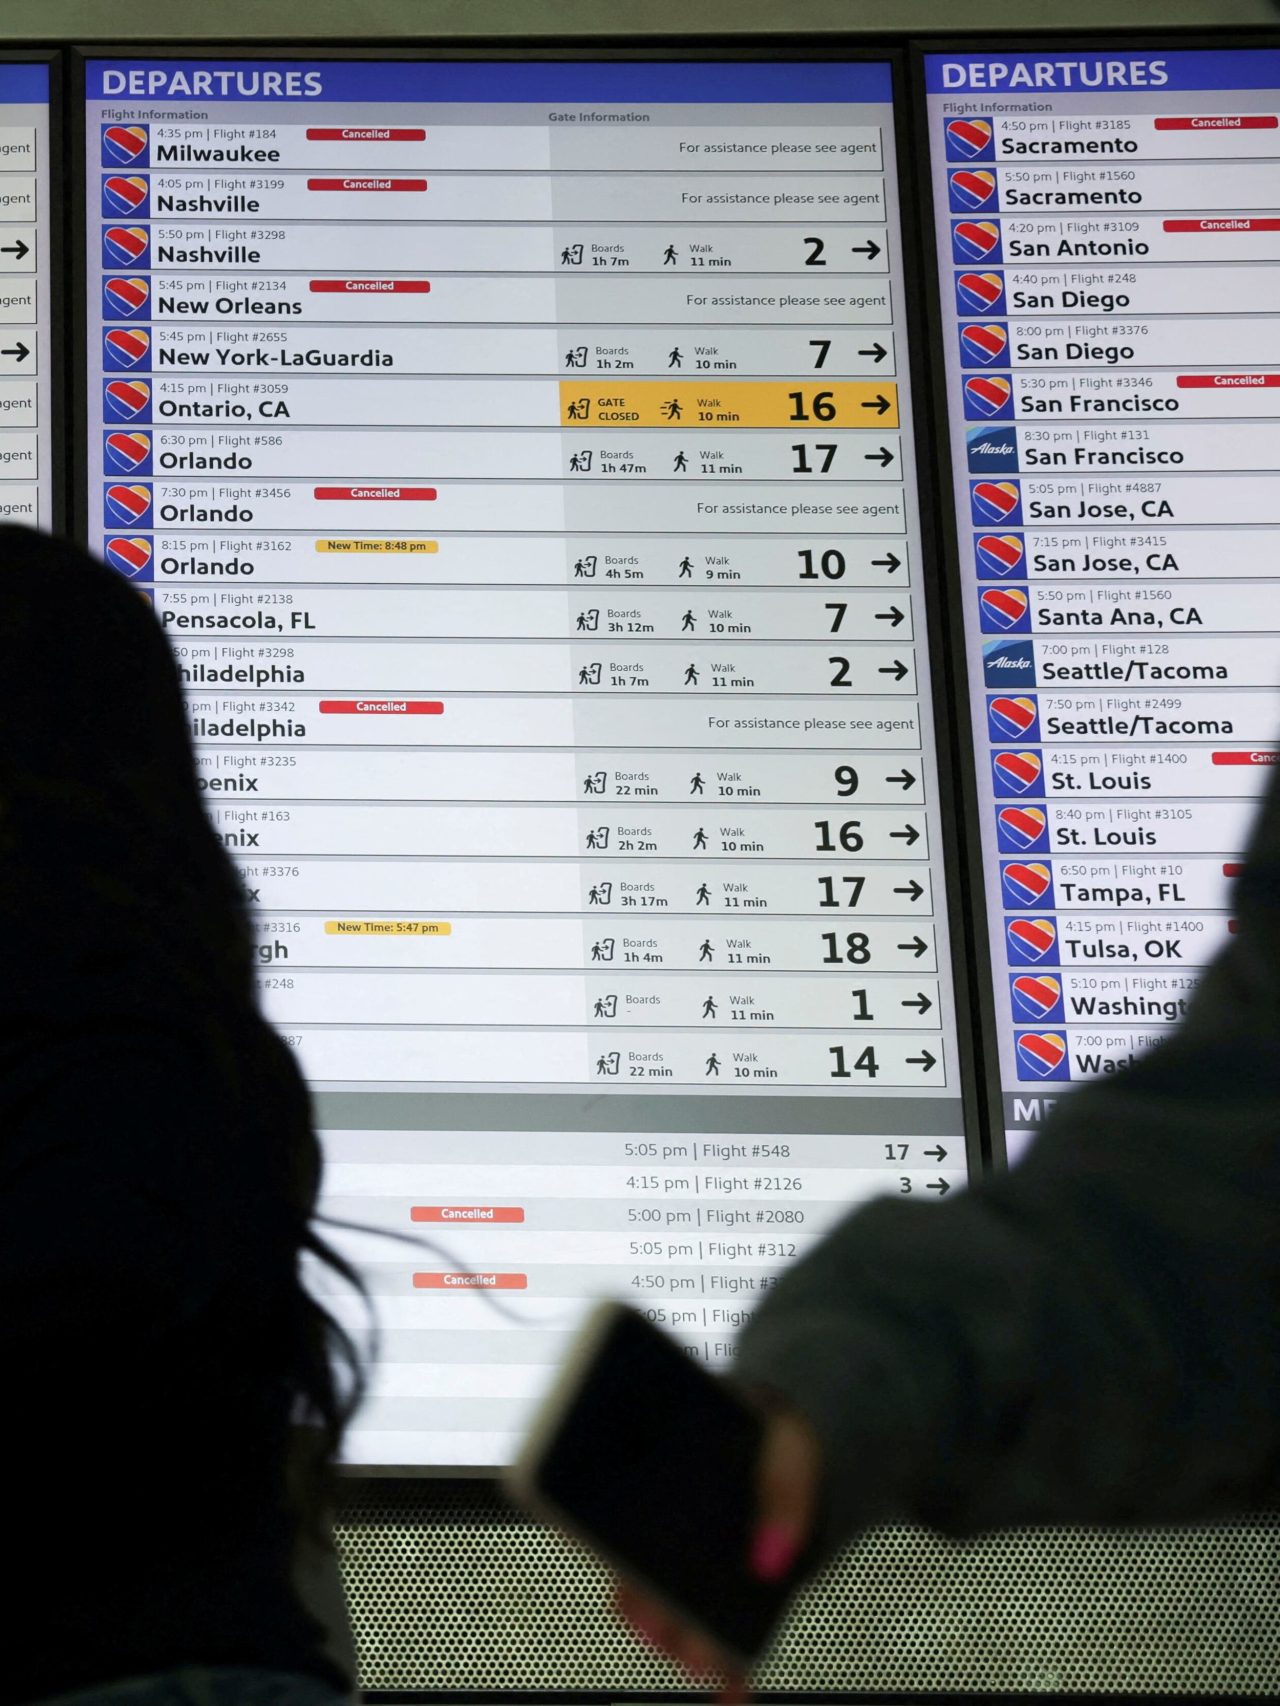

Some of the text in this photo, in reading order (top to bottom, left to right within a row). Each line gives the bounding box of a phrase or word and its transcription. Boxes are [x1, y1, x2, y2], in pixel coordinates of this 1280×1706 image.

[943, 61, 1168, 87] DEPARTURES
[103, 71, 322, 96] DEPARTURES
[102, 109, 208, 121] Flight Information
[549, 112, 649, 121] Gate Information
[943, 102, 1052, 115] Flight Information
[1001, 121, 1026, 130] 4:50
[1030, 123, 1048, 132] pm
[1060, 120, 1091, 132] Flight
[1096, 120, 1130, 129] #3185
[1192, 118, 1240, 127] Cancelled
[342, 130, 389, 138] Cancelled
[157, 145, 280, 162] Milwaukee
[1002, 138, 1137, 154] Sacramento
[158, 195, 259, 212] Nashville
[804, 238, 826, 265] 2
[1010, 239, 1149, 256] San Antonio
[159, 297, 302, 314] New Orleans
[1014, 291, 1129, 312] San Diego
[160, 349, 393, 366] New York-LaGuardia
[810, 340, 831, 368] 7
[159, 400, 290, 420] Ontario, CA
[697, 399, 720, 407] Walk
[789, 392, 836, 421] 16
[1021, 395, 1179, 412] San Francisco
[599, 412, 639, 420] CLOSED
[699, 412, 739, 421] 10 min
[161, 435, 185, 444] 6:30
[189, 438, 207, 447] pm
[219, 436, 250, 448] Flight
[255, 436, 282, 445] #586
[971, 444, 1014, 455] Alaska
[160, 452, 252, 469] Orlando
[792, 444, 837, 473] 17
[1030, 501, 1174, 520] San Jose, CA
[353, 542, 382, 550] Time:
[385, 542, 407, 550] 8:48
[410, 544, 426, 552] pm
[798, 550, 845, 579] 10
[162, 612, 315, 631] Pensacola, FL
[1039, 608, 1202, 628] Santa Ana, CA
[1043, 660, 1227, 681] Seattle/Tacoma
[835, 766, 858, 796] 9
[1052, 772, 1151, 789] St. Louis
[1060, 884, 1185, 906] Tampa, FL
[822, 932, 871, 964] 18
[1065, 939, 1182, 961] Tulsa, OK
[829, 1046, 879, 1077] 14
[441, 1209, 493, 1219] Cancelled
[629, 1209, 661, 1221] 5:00
[667, 1213, 691, 1225] pm
[707, 1210, 751, 1226] Flight
[756, 1211, 804, 1223] #2080
